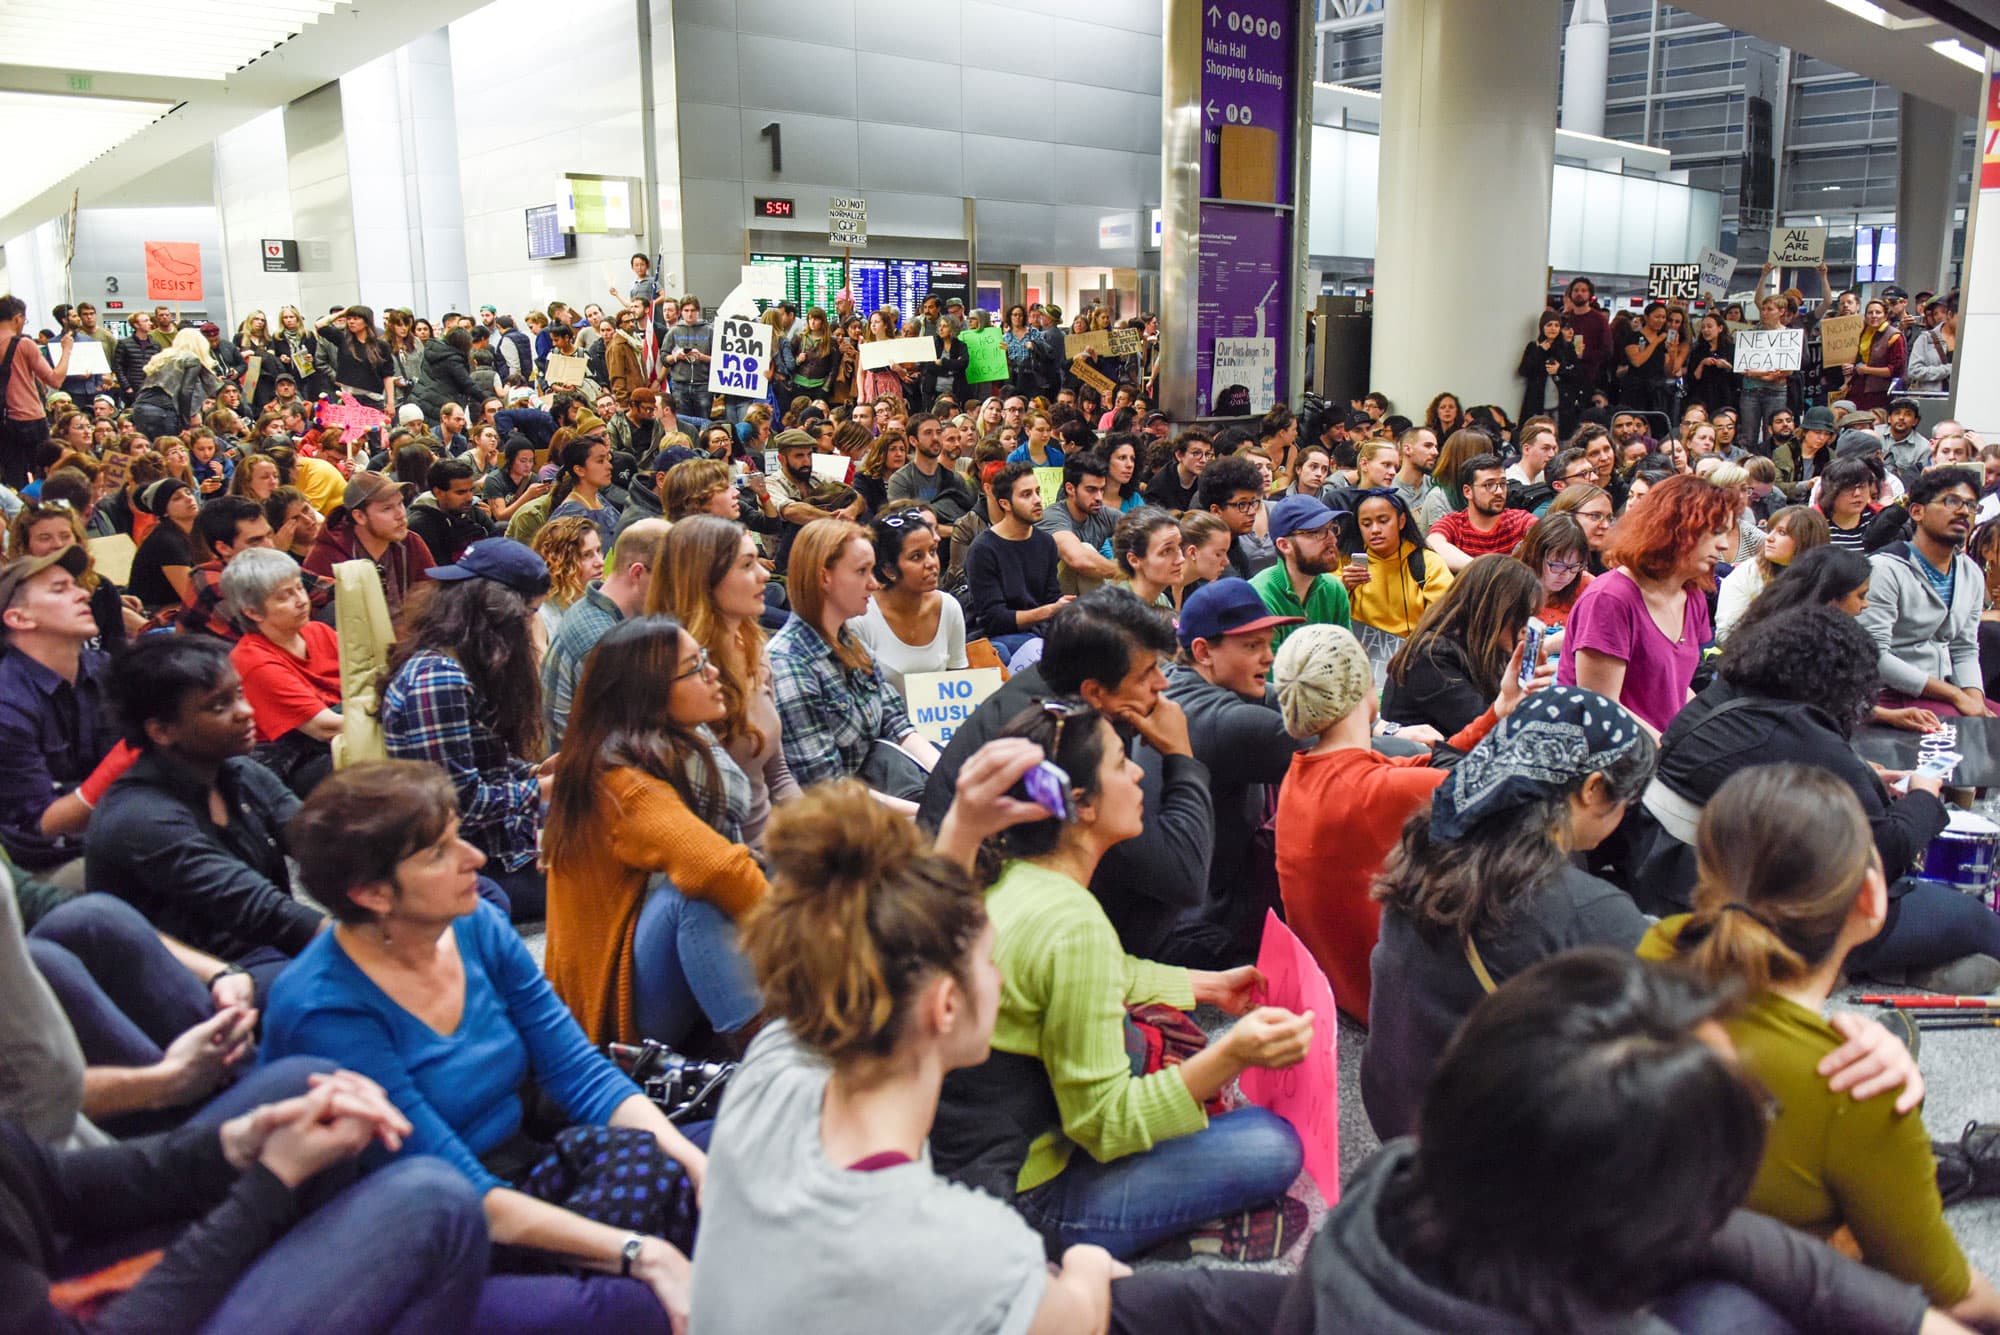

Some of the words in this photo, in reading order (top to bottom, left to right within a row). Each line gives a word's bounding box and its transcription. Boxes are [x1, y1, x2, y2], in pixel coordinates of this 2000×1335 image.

[1206, 37, 1227, 55] Main
[1229, 42, 1246, 59] Hall
[1206, 59, 1246, 83] Shopping
[1247, 66, 1254, 81] &
[1256, 68, 1283, 90] Dining
[761, 123, 781, 172] 1
[766, 202, 790, 214] 5:54
[835, 199, 846, 207] DO
[850, 201, 864, 209] NOT
[830, 211, 865, 220] NORMALIZE
[838, 220, 856, 230] GOP
[830, 232, 867, 243] PRINCIPLES
[1784, 230, 1809, 241] ALL
[1784, 242, 1809, 250] ARE
[1650, 265, 1700, 280] TRUMP
[106, 276, 119, 293] 3
[152, 278, 195, 291] RESIST
[1649, 280, 1698, 298] SUCKS
[723, 320, 754, 338] no
[720, 335, 763, 357] ban
[1739, 331, 1800, 348] NEVER
[723, 353, 758, 372] no
[1738, 352, 1800, 369] AGAIN
[717, 369, 759, 390] wall
[938, 680, 973, 700] NO
[917, 704, 980, 723] MUSL
